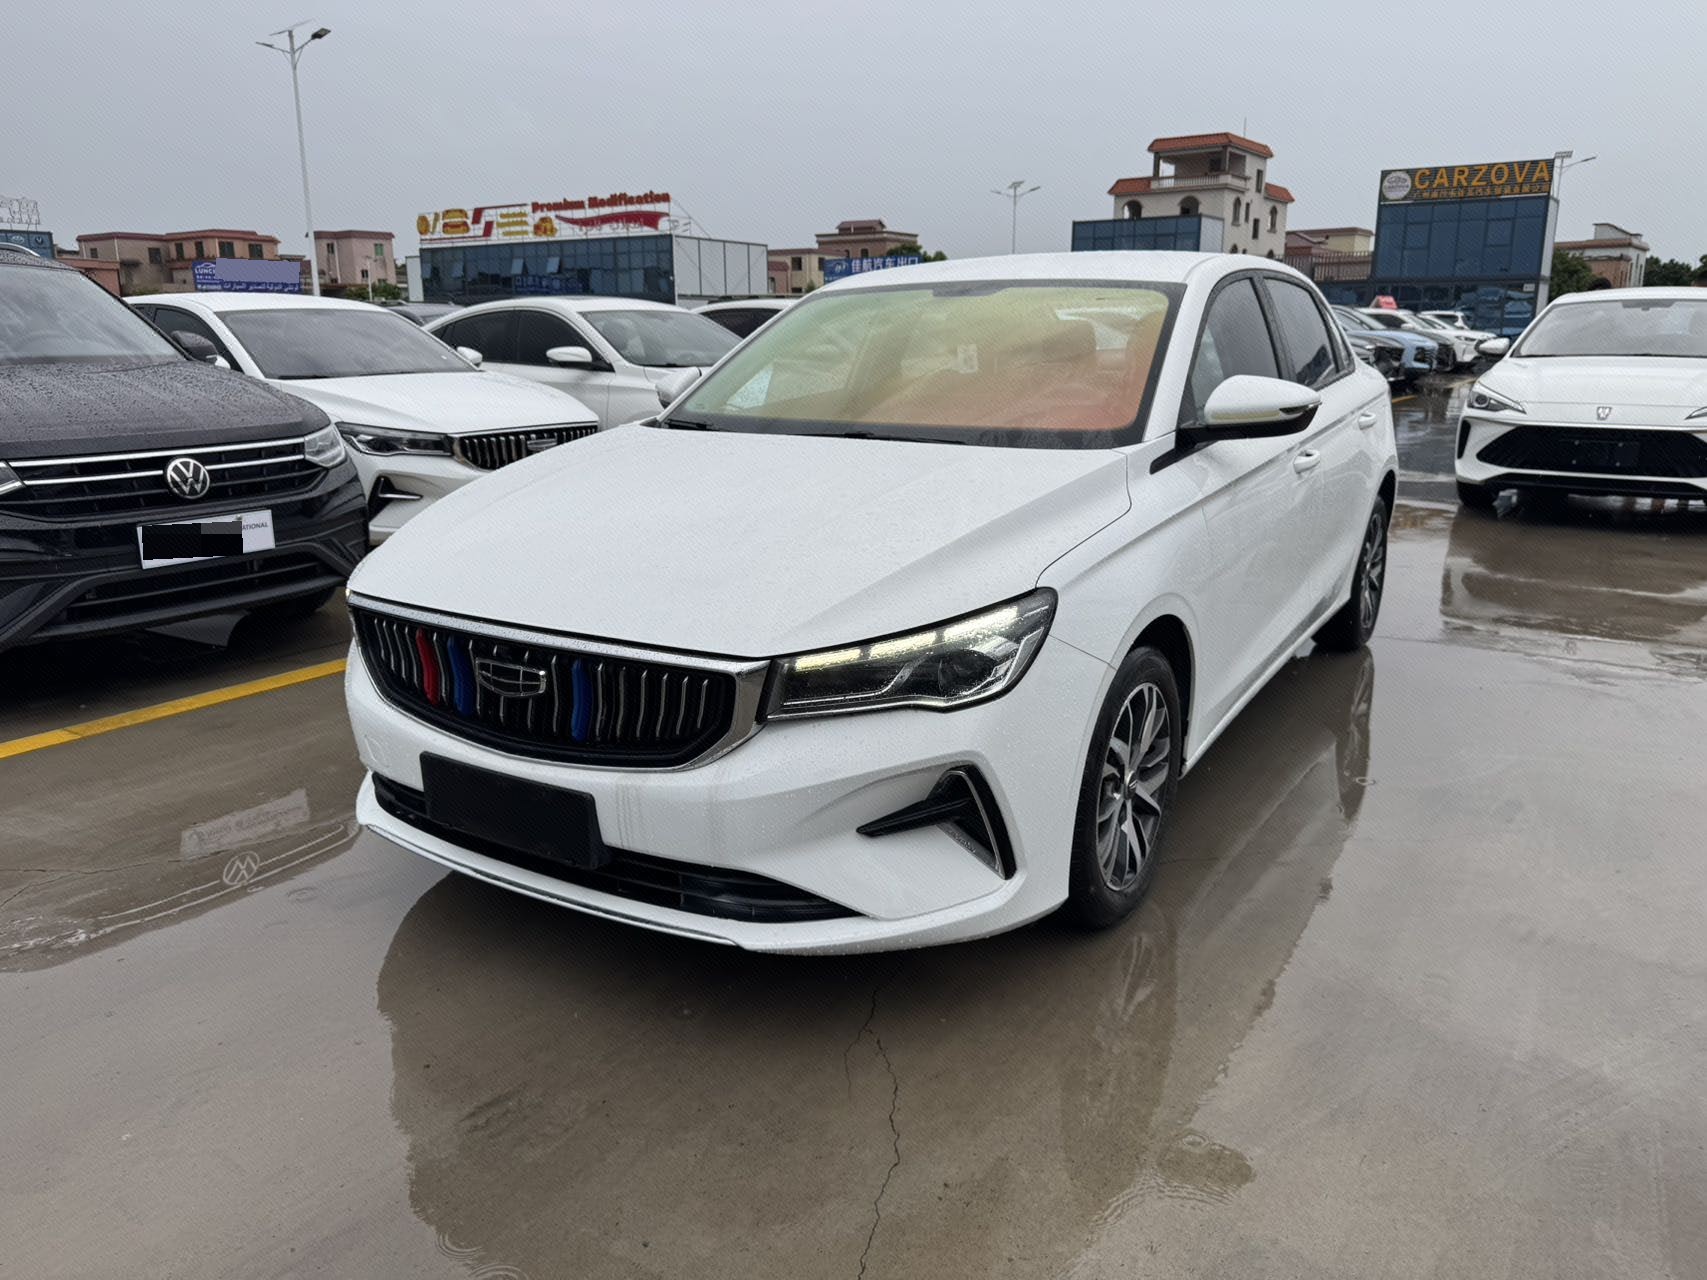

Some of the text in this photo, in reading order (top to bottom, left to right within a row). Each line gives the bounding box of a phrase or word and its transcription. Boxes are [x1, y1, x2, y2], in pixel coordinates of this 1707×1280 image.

[1414, 161, 1551, 189] CARZOVA
[531, 189, 670, 213] Premium Modification
[242, 521, 268, 531] ATIONAL
